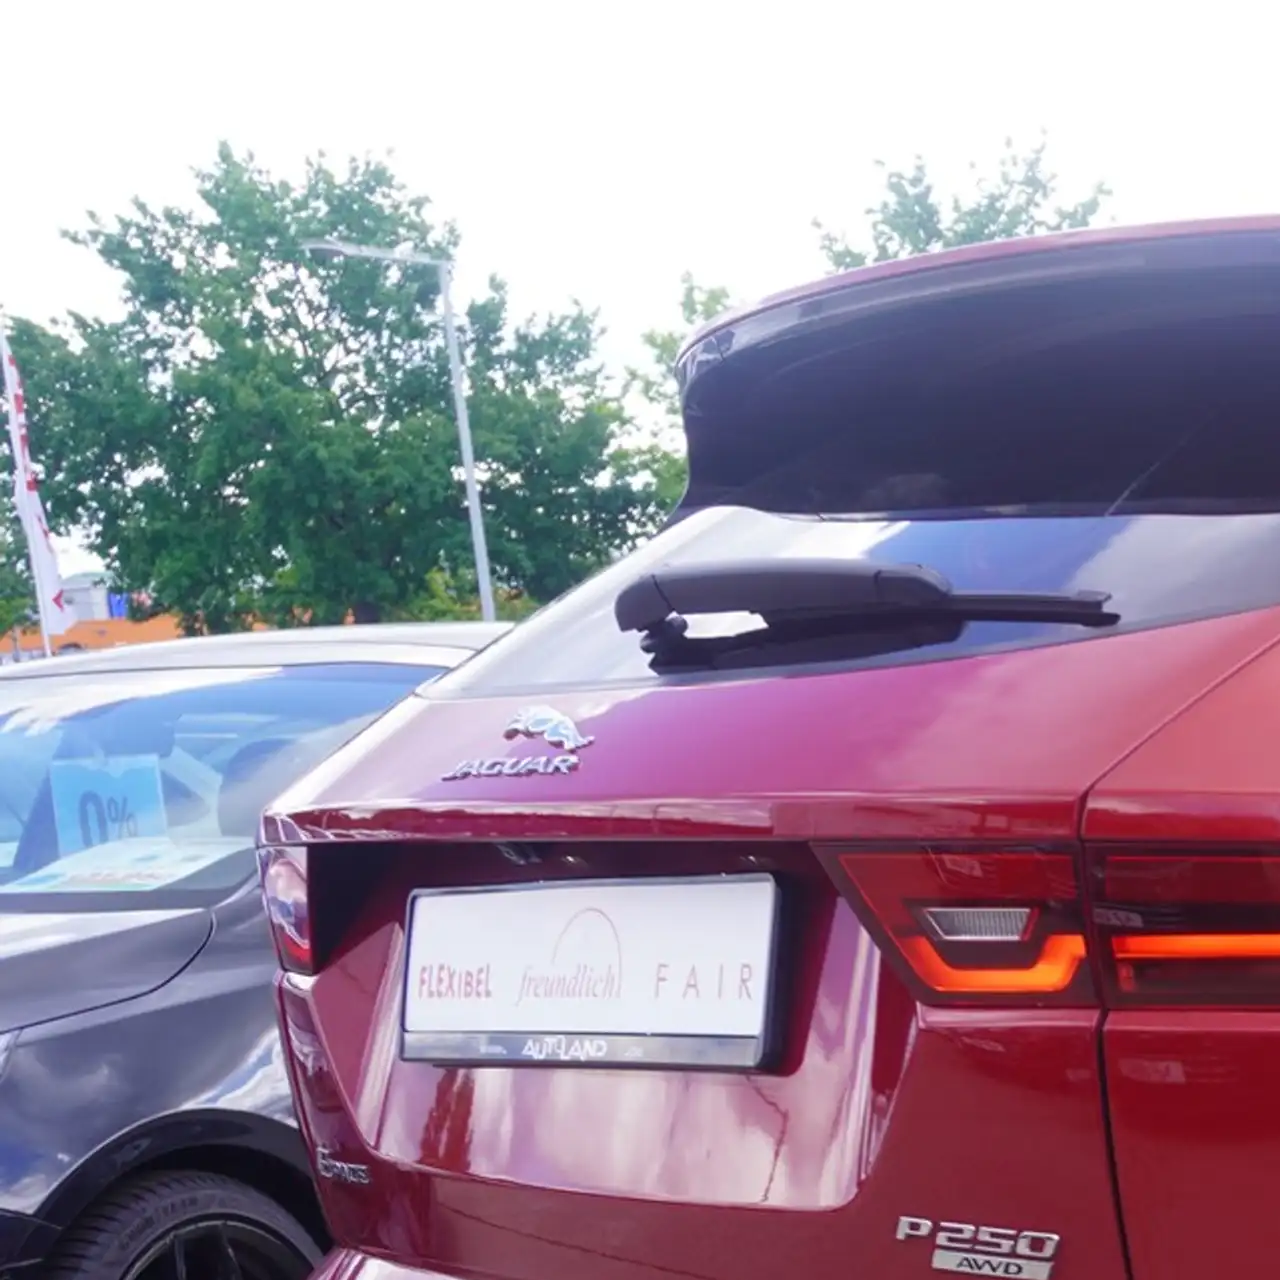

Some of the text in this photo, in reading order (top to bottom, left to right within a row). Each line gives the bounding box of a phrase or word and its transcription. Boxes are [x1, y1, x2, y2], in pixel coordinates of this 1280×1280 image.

[442, 755, 579, 781] JAGUAR
[418, 963, 493, 999] FLEXIBEL
[515, 963, 616, 1006] freundlich
[895, 1215, 1060, 1258] P250
[956, 1256, 1023, 1276] AWD
